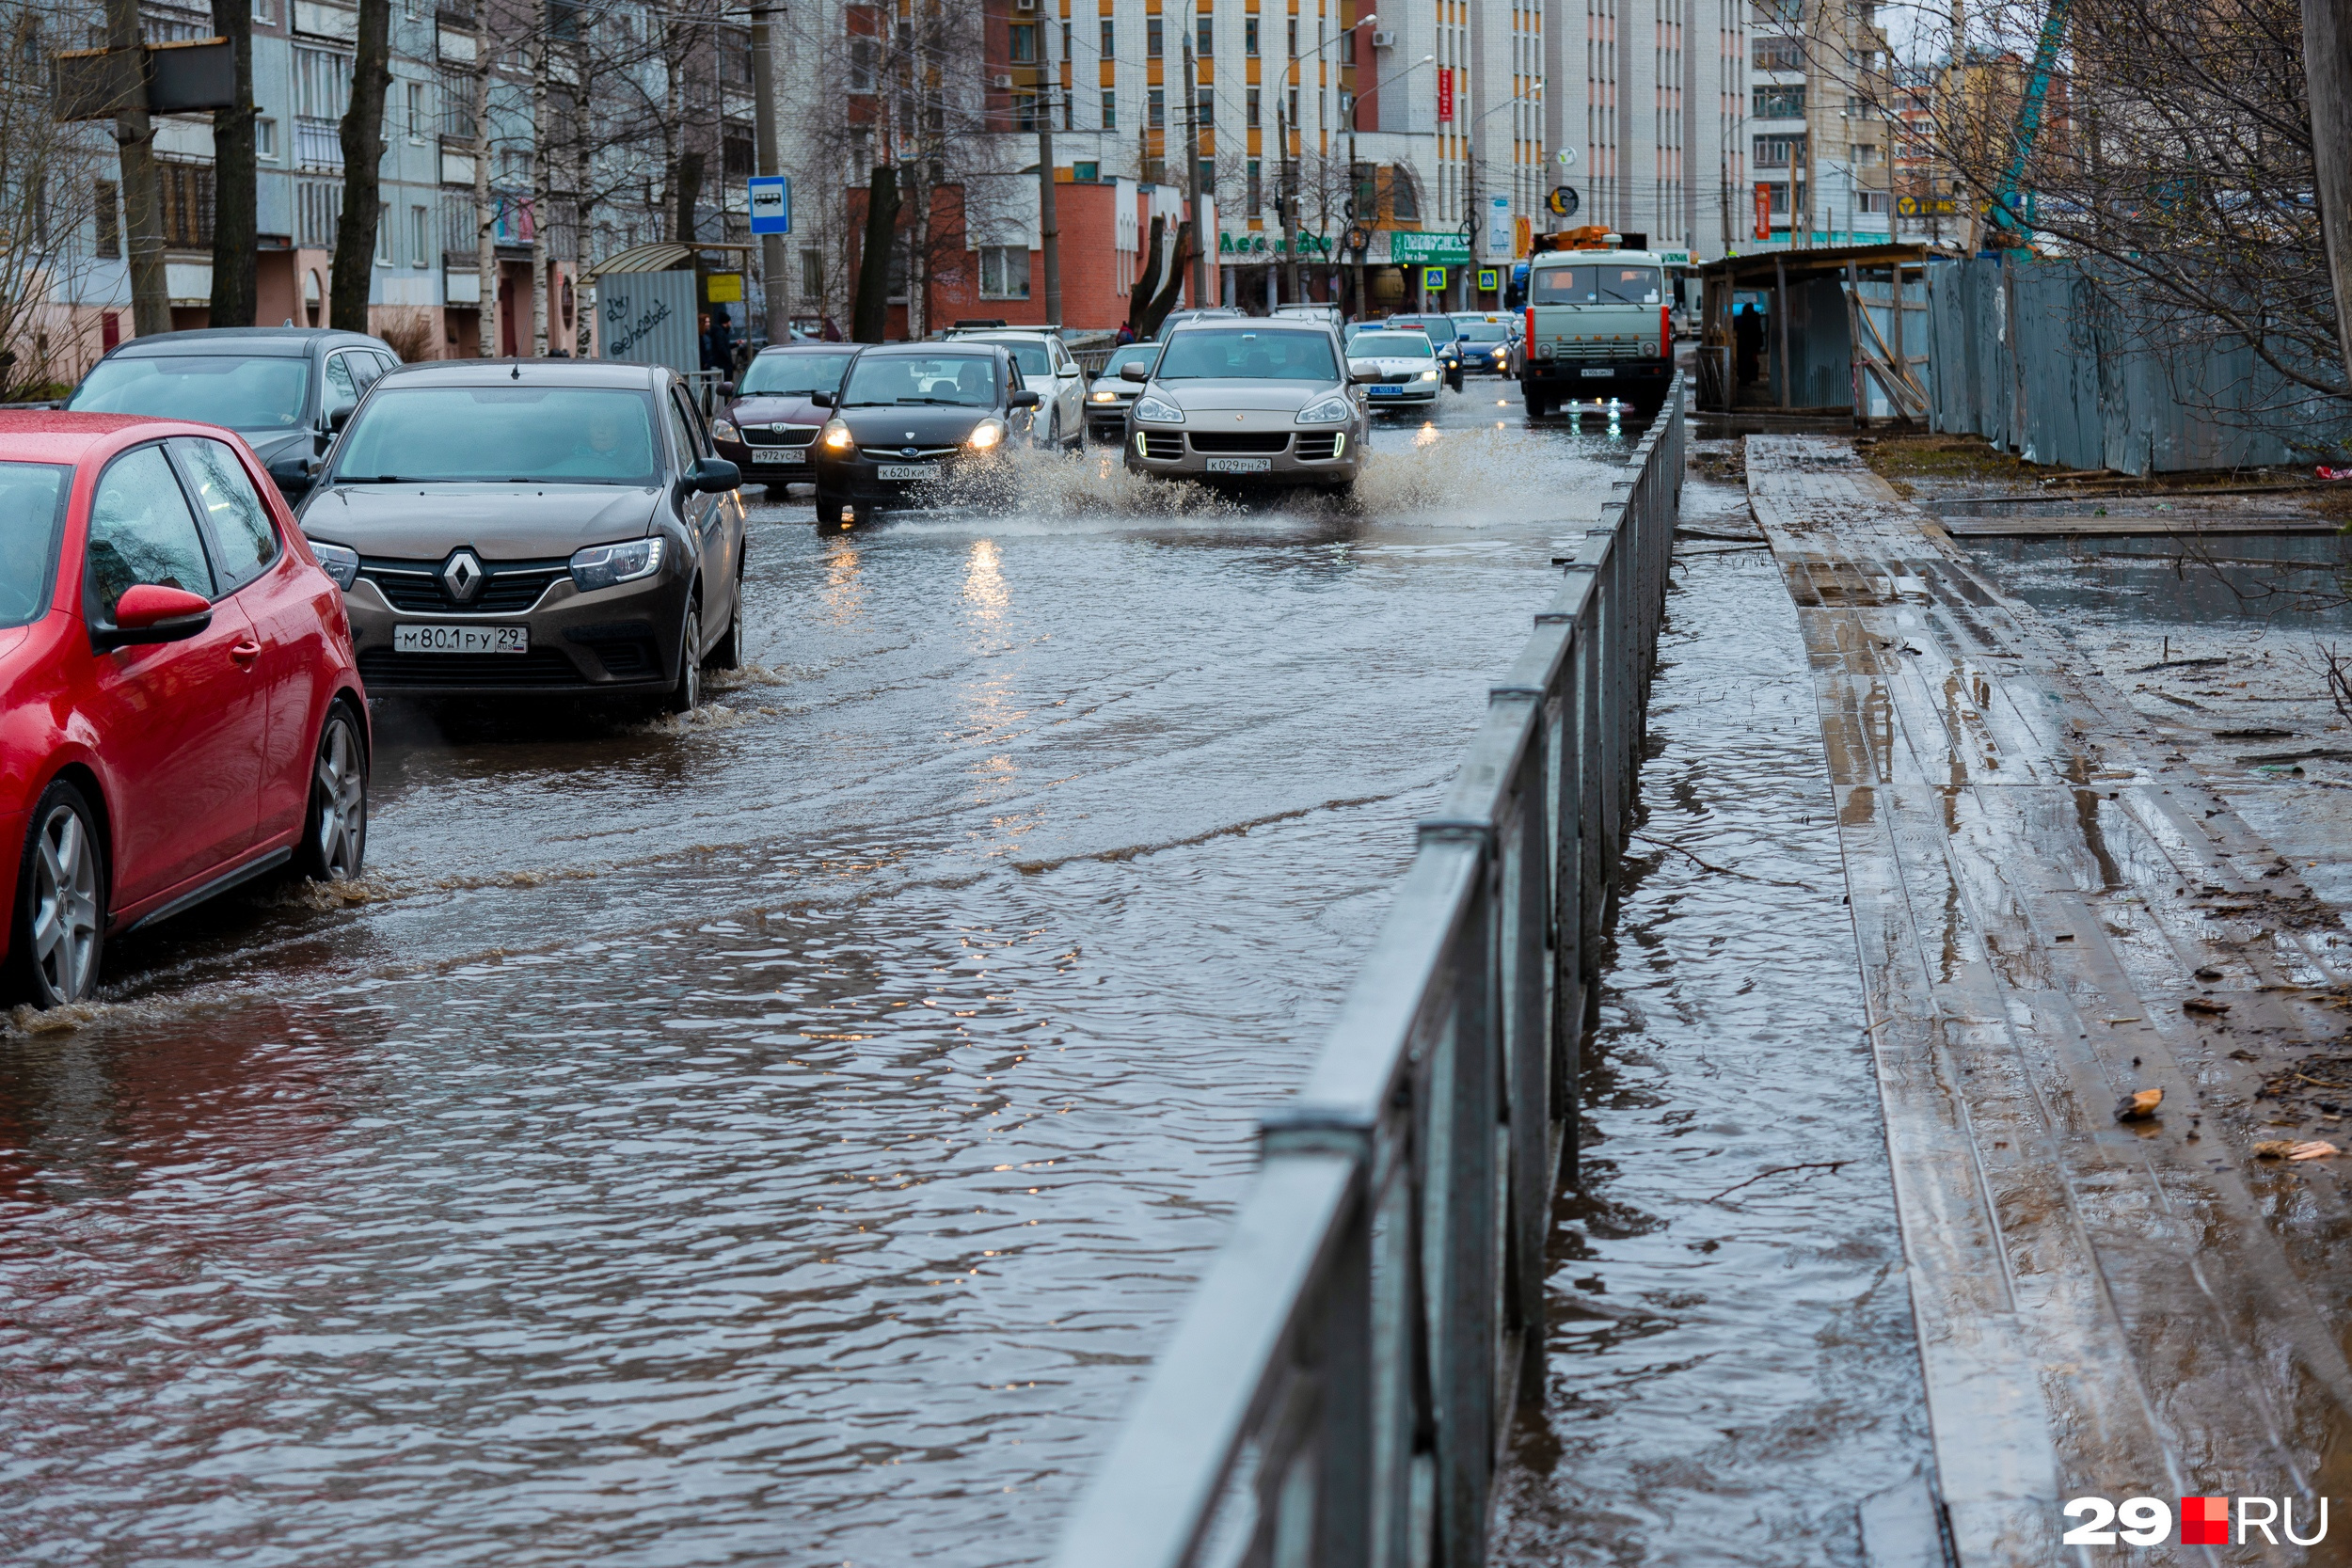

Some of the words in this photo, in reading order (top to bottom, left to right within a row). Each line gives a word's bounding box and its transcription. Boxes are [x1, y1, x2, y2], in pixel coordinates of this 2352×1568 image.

[1256, 460, 1267, 468] 29
[404, 628, 491, 650] М801РУ
[498, 628, 518, 644] 29
